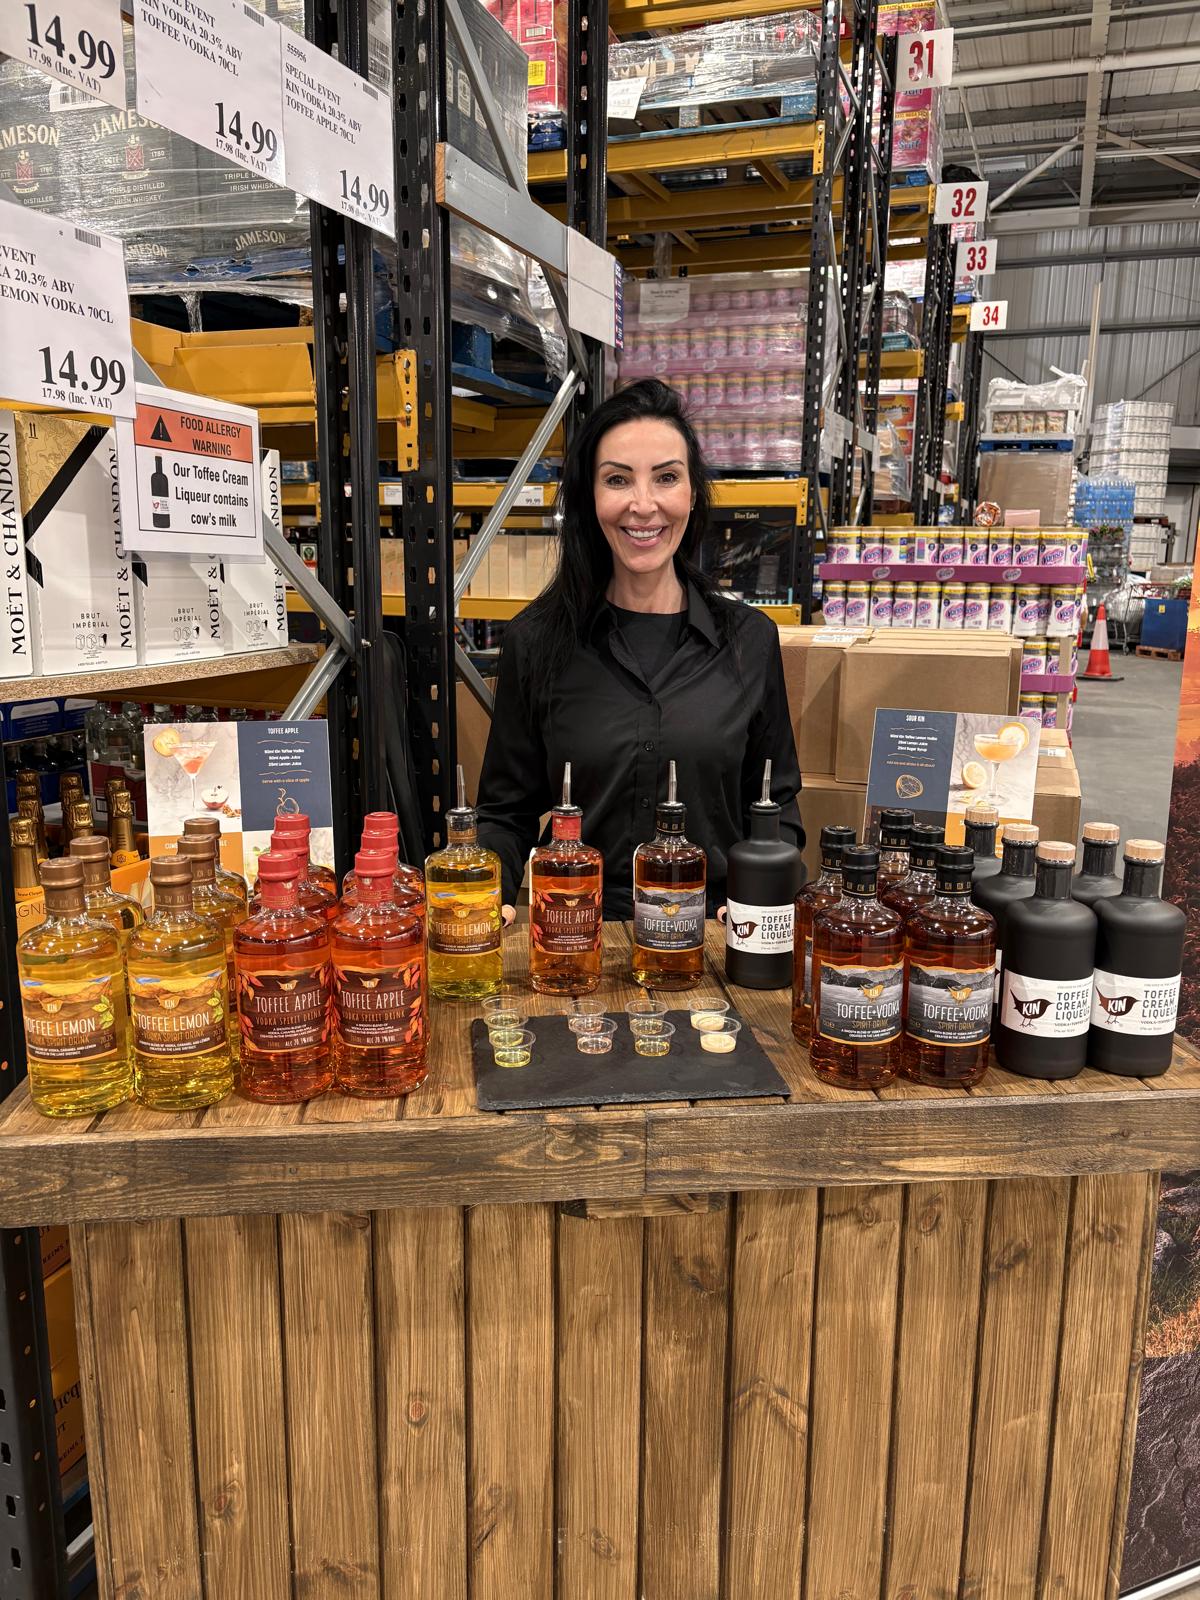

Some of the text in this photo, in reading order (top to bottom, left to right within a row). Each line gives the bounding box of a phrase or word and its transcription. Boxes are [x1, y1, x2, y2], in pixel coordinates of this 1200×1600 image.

[185, 0, 215, 28] EVENT
[24, 3, 116, 79] 14.99
[162, 2, 197, 34] VODKA
[199, 26, 223, 50] 20.3%
[226, 44, 243, 60] ABV
[141, 8, 239, 76] TOFFEE VODKA 70CL
[28, 47, 101, 93] 17.98 (Inc. VAT)
[908, 39, 935, 81] 31
[285, 62, 341, 106] SPECIAL EVENT
[285, 78, 363, 133] KIN VODKA 20.3% ABV
[89, 109, 160, 142] JAMES
[285, 95, 356, 144] TOFFEE APPLE 70CL
[215, 102, 278, 162] 14.99
[216, 137, 234, 154] 17.98
[250, 154, 267, 172] VAT)
[224, 172, 249, 180] TRIPLE
[230, 184, 249, 192] IRISH
[339, 169, 389, 217] 14.99
[951, 187, 977, 218] 32
[235, 230, 286, 251] JAMESON
[0, 245, 37, 266] VENT
[966, 246, 987, 271] 33
[14, 268, 48, 288] 20.3%
[51, 278, 75, 295] ABV
[0, 283, 114, 324] EMON VODKA 70CL
[982, 306, 999, 326] 34
[38, 345, 126, 396] 14.99
[42, 387, 113, 410] 17.98 (Inc. VAT)
[180, 416, 241, 438] FOOD ALLERGY
[192, 438, 232, 456] WARNING
[173, 462, 249, 486] Our Toffee Cream
[175, 486, 249, 507] Liqueur contains
[190, 512, 237, 527] cow's milk
[0, 432, 27, 656] MOËT & CHANDON
[116, 567, 130, 581] &
[207, 566, 221, 640] MOËT &
[273, 582, 286, 631] MOËT
[80, 612, 101, 620] BRUT
[117, 587, 133, 649] MOËT
[545, 908, 595, 924] TOFFEE APPLE
[761, 913, 792, 924] TOFFEE
[463, 920, 491, 937] LEMON
[736, 922, 750, 936] KIN
[761, 922, 791, 932] CREAM
[255, 989, 321, 1014] TOFFEE APPLE
[341, 989, 405, 1010] TOFFEE APPLE
[1056, 988, 1090, 1001] TOFFEE
[1142, 997, 1175, 1009] CREAM
[1144, 987, 1177, 999] TOFFEE
[1022, 1000, 1041, 1016] KIN
[1056, 998, 1088, 1011] CREAM
[1108, 998, 1127, 1013] KIN
[137, 1012, 210, 1032] TOFFEE LEMON
[255, 1009, 322, 1026] VODKA SPIRIT DRINK
[361, 1012, 382, 1022] SPIRIT
[384, 1009, 405, 1021] DRINK
[55, 1017, 96, 1036] LEMON
